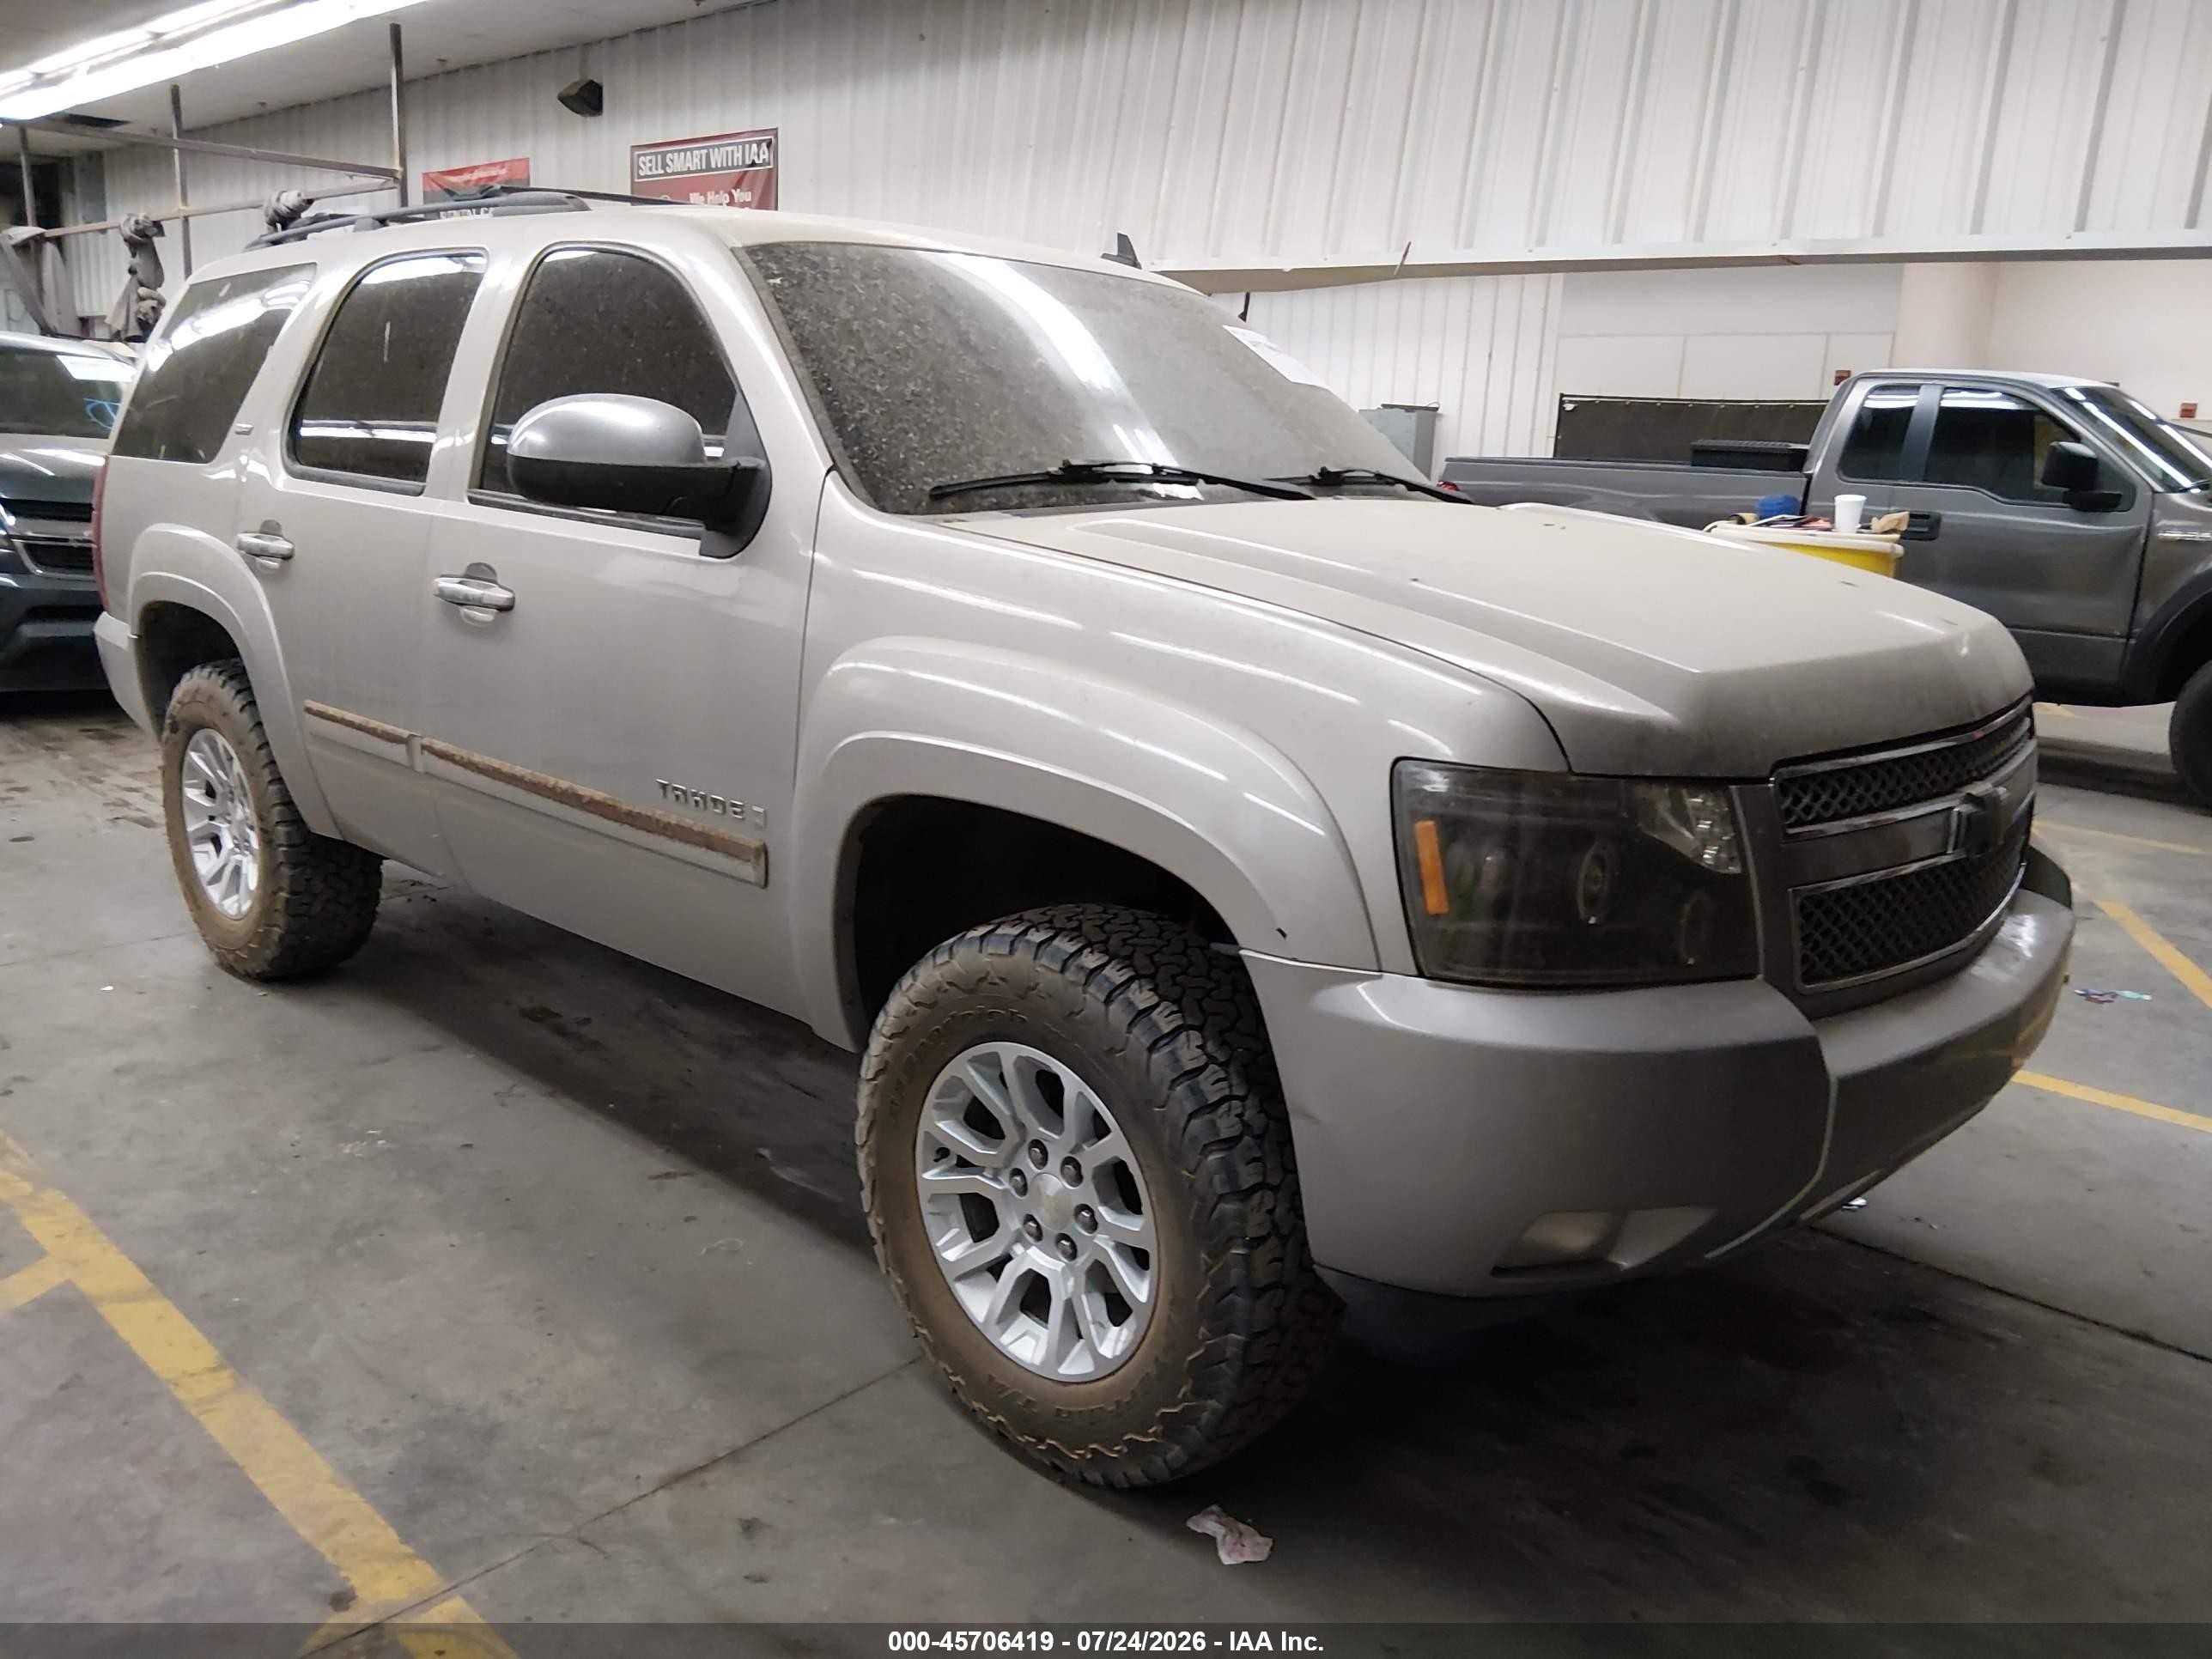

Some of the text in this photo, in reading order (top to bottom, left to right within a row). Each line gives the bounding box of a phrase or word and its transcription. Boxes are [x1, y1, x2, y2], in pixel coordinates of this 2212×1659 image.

[638, 142, 769, 176] SELL SMART WITH IAA
[731, 188, 752, 203] You
